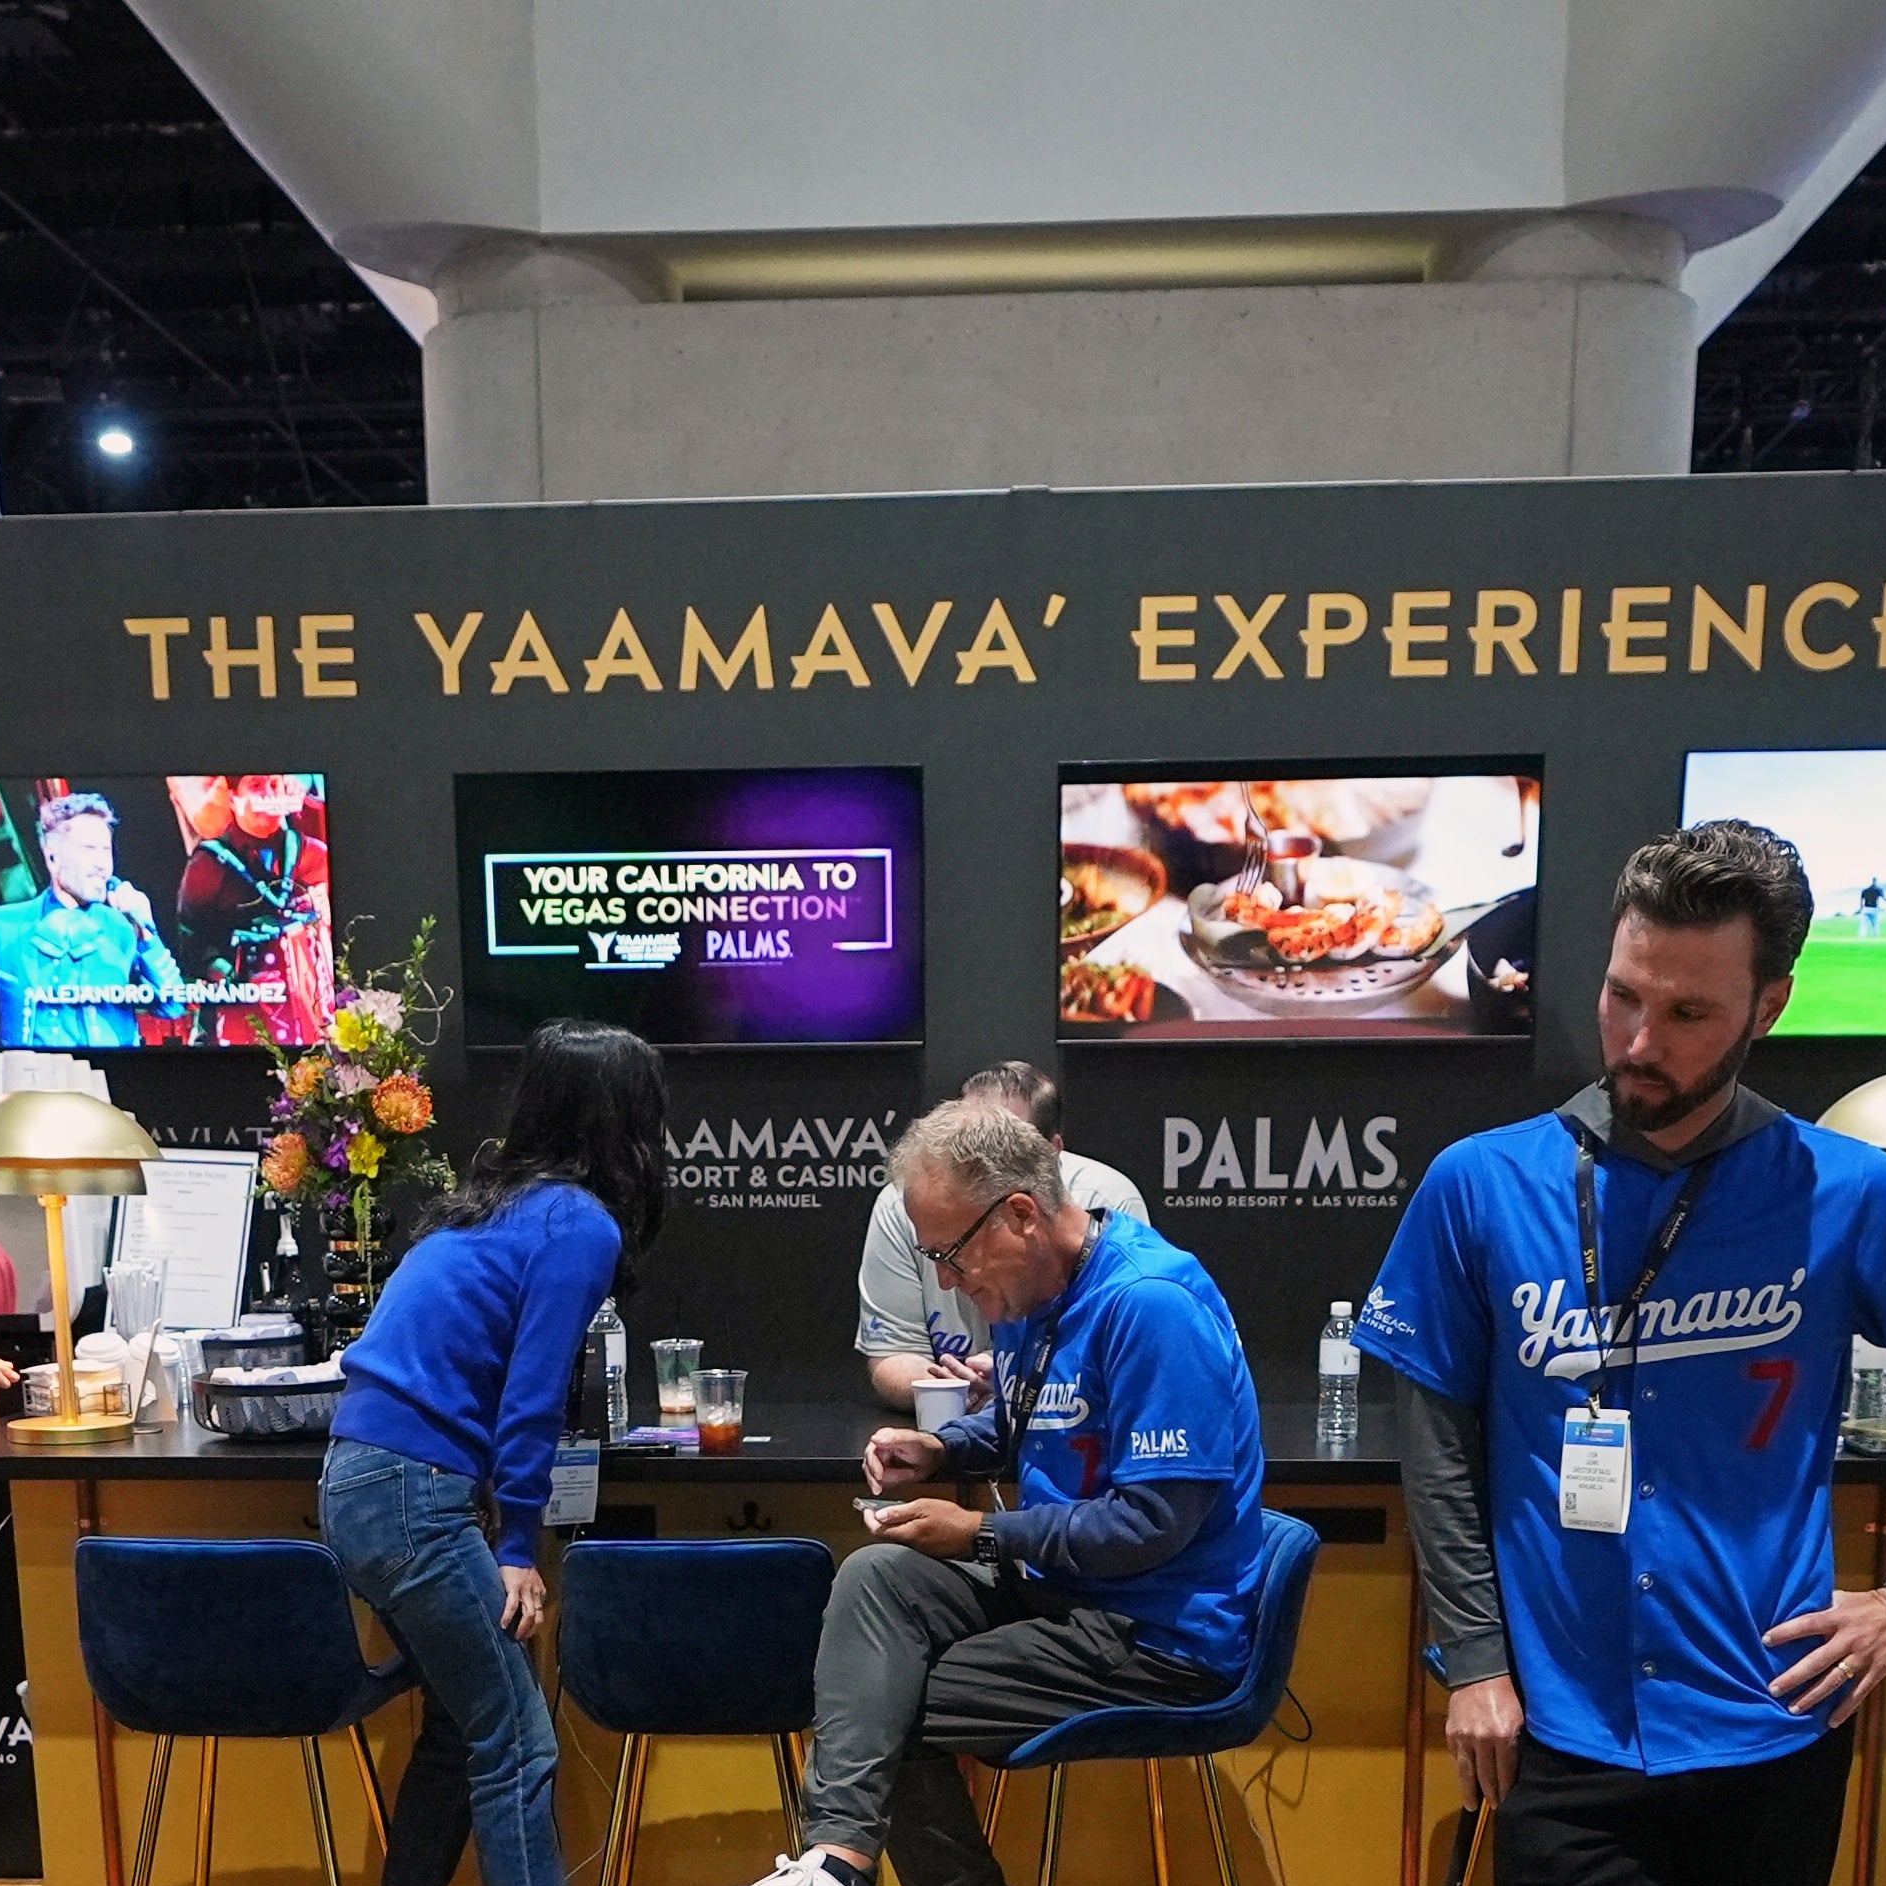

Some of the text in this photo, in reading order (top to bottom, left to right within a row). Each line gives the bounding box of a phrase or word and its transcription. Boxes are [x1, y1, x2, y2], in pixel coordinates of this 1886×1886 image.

[121, 610, 358, 702] THE
[524, 862, 858, 895] YOUR CALIFORNIA TO
[519, 894, 849, 926] VEGAS CONNECTION
[706, 929, 792, 960] PALMS
[32, 978, 287, 1005] ALEJANDRO FERNÁNDEZ
[1163, 1115, 1399, 1190] PALMS
[748, 1164, 768, 1188] &
[776, 1164, 890, 1188] CASINO
[708, 1194, 745, 1209] SAN
[748, 1193, 822, 1209] MANUEL
[1164, 1195, 1399, 1208] CASINO RESORT LAS VEGAS
[1585, 1247, 1596, 1284] PALMS
[1631, 1267, 1657, 1302] PALMS
[1360, 1314, 1394, 1335] LINKS
[1373, 1310, 1417, 1337] BEACH
[1745, 1358, 1796, 1450] 7
[1130, 1427, 1189, 1454] PALMS
[1070, 1436, 1105, 1500] 7
